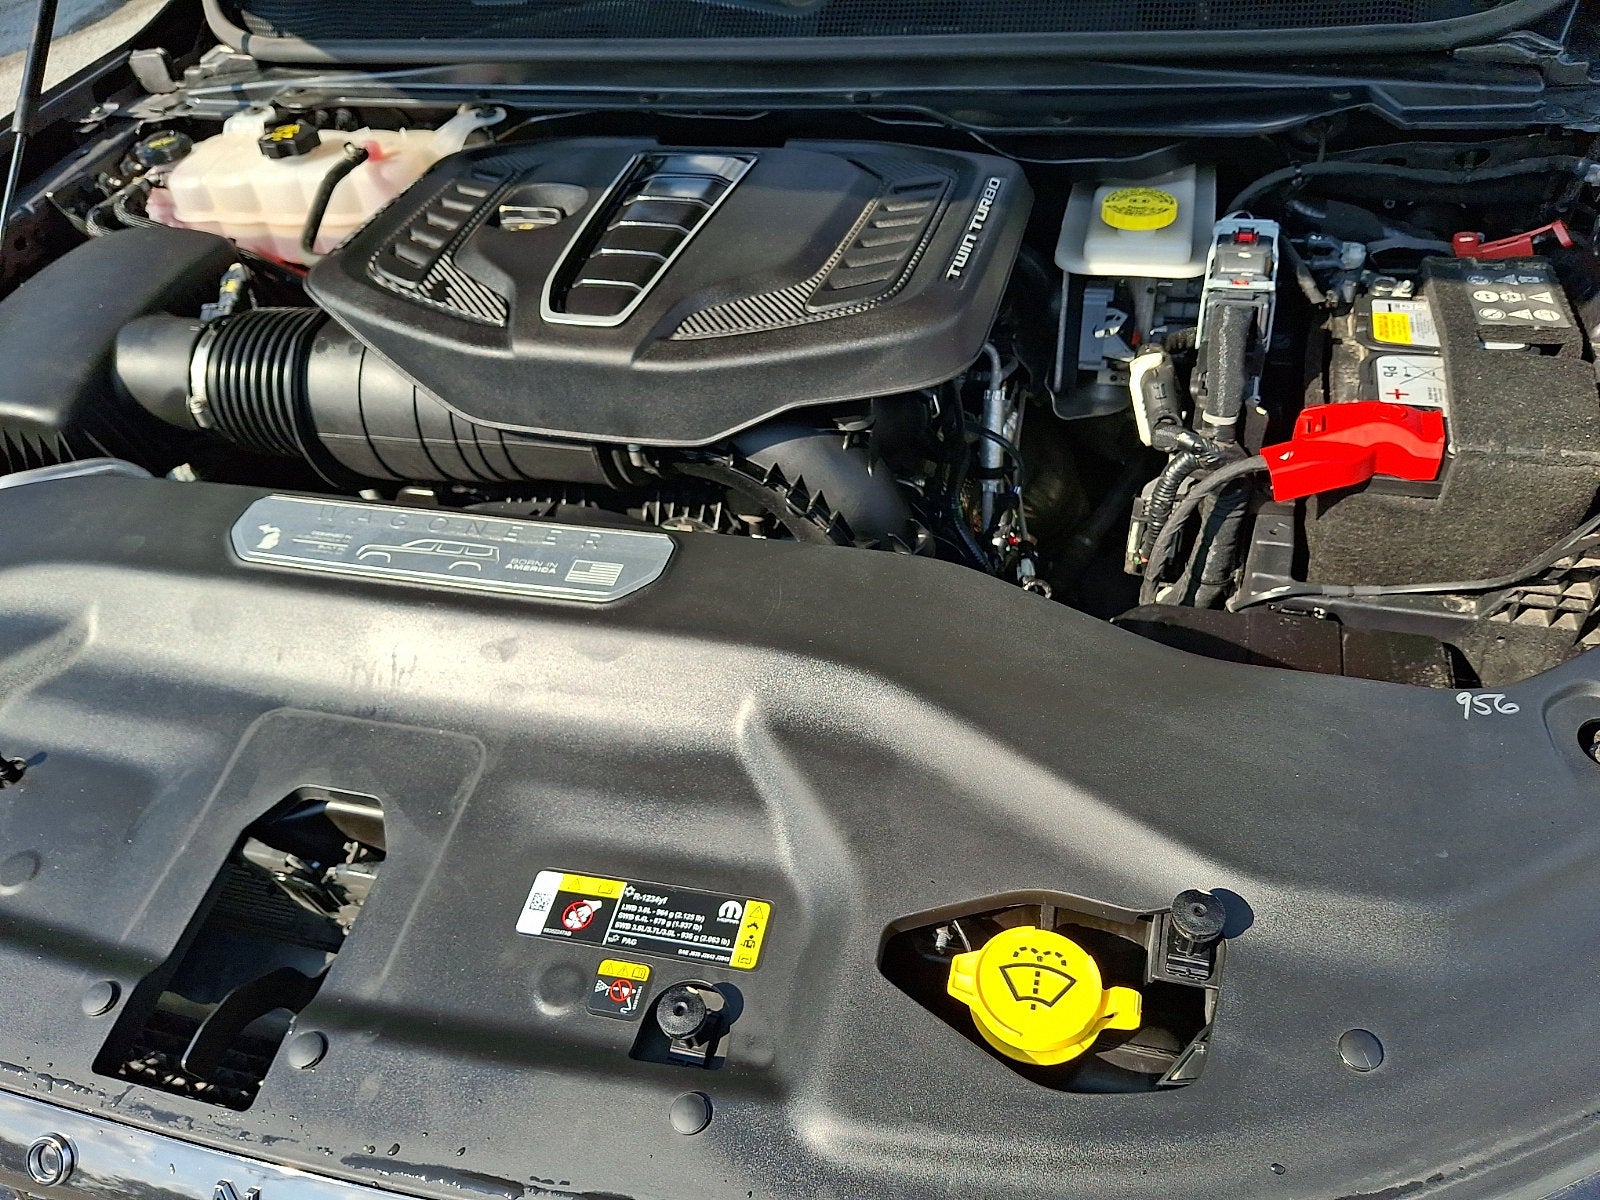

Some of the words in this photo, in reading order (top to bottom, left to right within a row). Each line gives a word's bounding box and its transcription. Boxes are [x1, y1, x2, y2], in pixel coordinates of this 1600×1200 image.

[945, 233, 978, 281] TWIN
[968, 176, 1001, 231] TURBO
[1382, 365, 1398, 378] Pb
[505, 562, 557, 574] AMERICA
[1455, 691, 1520, 720] 956
[621, 936, 638, 946] PAG
